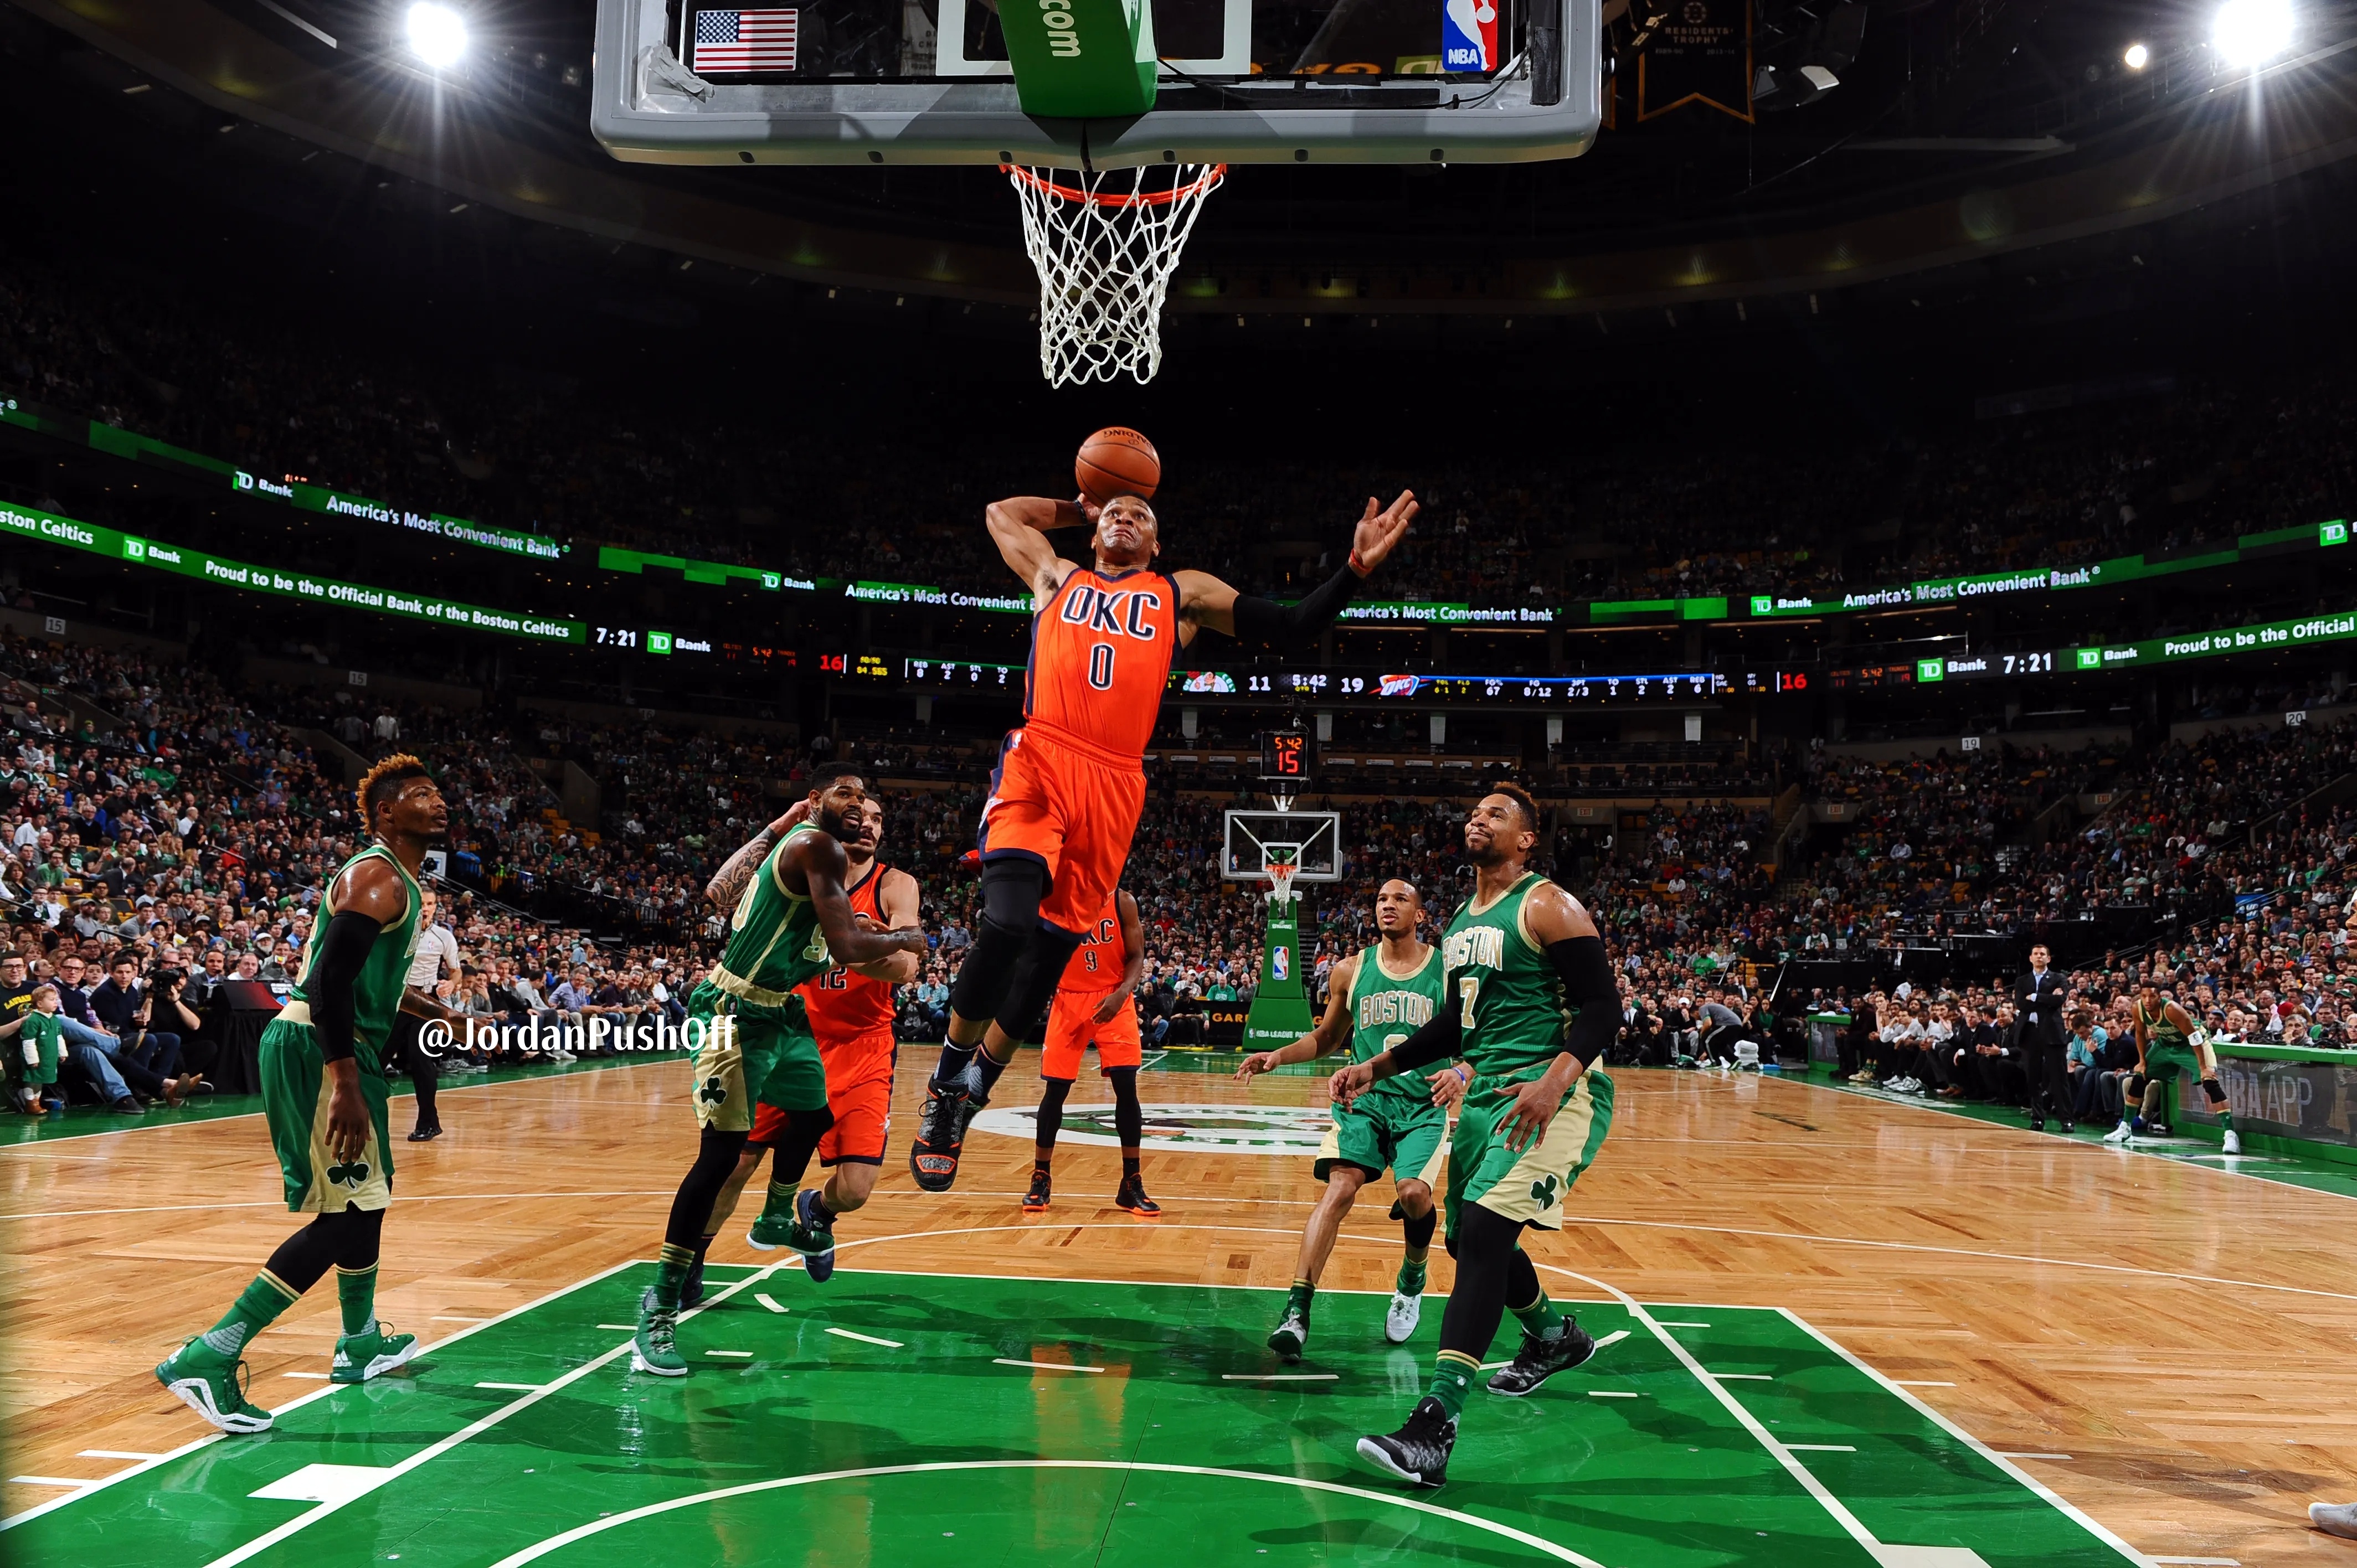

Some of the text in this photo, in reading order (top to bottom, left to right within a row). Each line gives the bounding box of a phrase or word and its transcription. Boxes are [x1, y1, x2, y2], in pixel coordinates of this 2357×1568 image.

[1672, 35, 1719, 44] TROPHY
[1448, 48, 1479, 65] NBA
[235, 471, 294, 498] TD Bank
[40, 519, 94, 545] Celtics
[326, 495, 400, 525] America's
[404, 511, 441, 534] Most
[444, 520, 524, 551] Convenient
[2322, 524, 2345, 541] TD
[125, 539, 569, 638] TD Bank Proud to be the Official Bank of the Boston Celtics
[762, 574, 778, 588] TD
[784, 577, 815, 590] Bank
[845, 584, 910, 602] America's
[914, 589, 947, 605] Most
[950, 592, 1026, 611] Convenient
[1754, 600, 1771, 612] TD
[1778, 597, 1812, 608] Bank
[1843, 587, 1912, 608] America's
[1916, 584, 1954, 601] Most
[1957, 573, 2046, 596] Convenient
[1061, 585, 1161, 641] OKC
[1403, 606, 1437, 620] Most
[1440, 606, 1517, 621] Convenient
[1520, 608, 1553, 622] Bank
[48, 619, 61, 631] 15
[596, 627, 636, 647] 7:21
[650, 635, 711, 652] TD Bank
[2080, 616, 2354, 665] TD Bank Proud to be the Official
[820, 655, 843, 670] 16
[1088, 643, 1115, 691] 0
[1920, 658, 1987, 678] TD Bank
[2003, 652, 2051, 674] 7:21
[352, 673, 364, 684] 15
[944, 670, 951, 680] 2
[999, 674, 1005, 684] 2
[1249, 676, 1271, 691] 11
[1293, 674, 1327, 686] 5:42
[1341, 677, 1364, 693] 19
[1380, 678, 1412, 696] OKC
[1529, 679, 1540, 687] FG
[1608, 678, 1619, 686] TO
[1635, 677, 1649, 685] STL
[1663, 676, 1678, 684] AST
[1782, 673, 1807, 689] 16
[1486, 687, 1500, 696] 67
[1568, 686, 1589, 697] 2/3
[1610, 686, 1617, 696] 1
[1638, 685, 1645, 695] 2
[1666, 684, 1674, 694] 2
[1694, 683, 1702, 693] 6
[2288, 714, 2303, 725] 20
[1964, 739, 1977, 749] 19
[1278, 750, 1299, 772] 15
[1443, 926, 1505, 972] BOSTON
[1084, 949, 1098, 972] 9
[819, 966, 847, 990] 12
[1359, 990, 1433, 1030] BOSTON
[1459, 977, 1480, 1029] 7
[2266, 1075, 2312, 1125] APP
